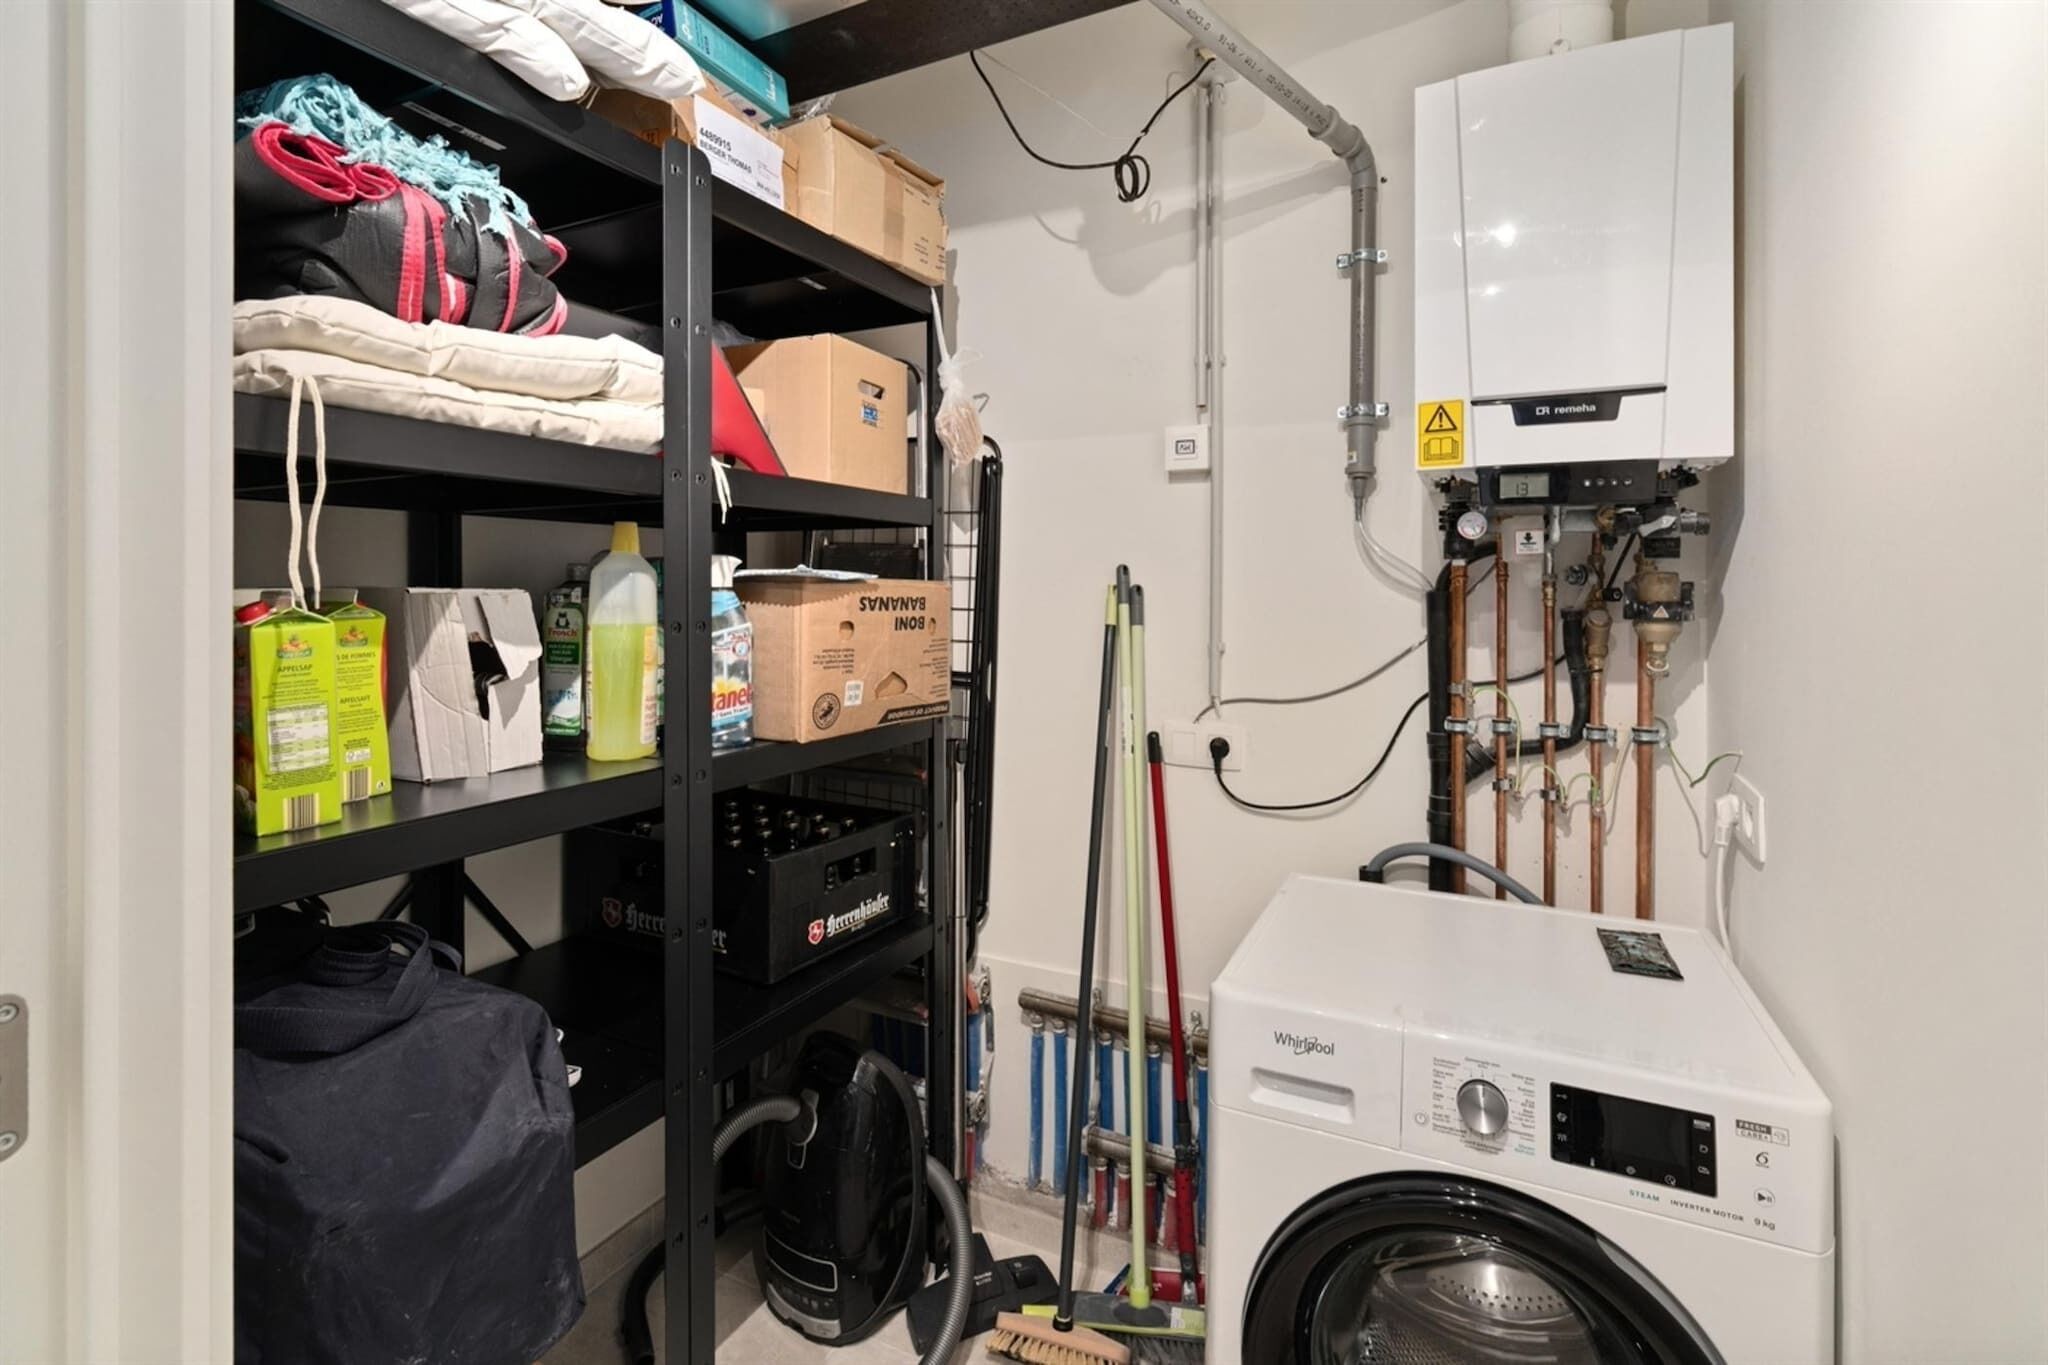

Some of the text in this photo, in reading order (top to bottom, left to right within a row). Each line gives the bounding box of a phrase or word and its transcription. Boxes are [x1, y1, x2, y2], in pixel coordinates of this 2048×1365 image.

[700, 140, 753, 174] BERGER THOMAS
[1554, 403, 1597, 415] remeha
[859, 596, 926, 612] BANANAS
[895, 616, 926, 631] BONI
[548, 627, 578, 637] Frosch
[277, 664, 313, 673] APPELSAP
[1274, 1031, 1335, 1056] Whirlpool
[1738, 1121, 1768, 1134] FRESH
[1629, 1189, 1660, 1202] STEAM
[1670, 1199, 1744, 1222] INVERTER MOTOR
[1762, 1219, 1776, 1231] kg
